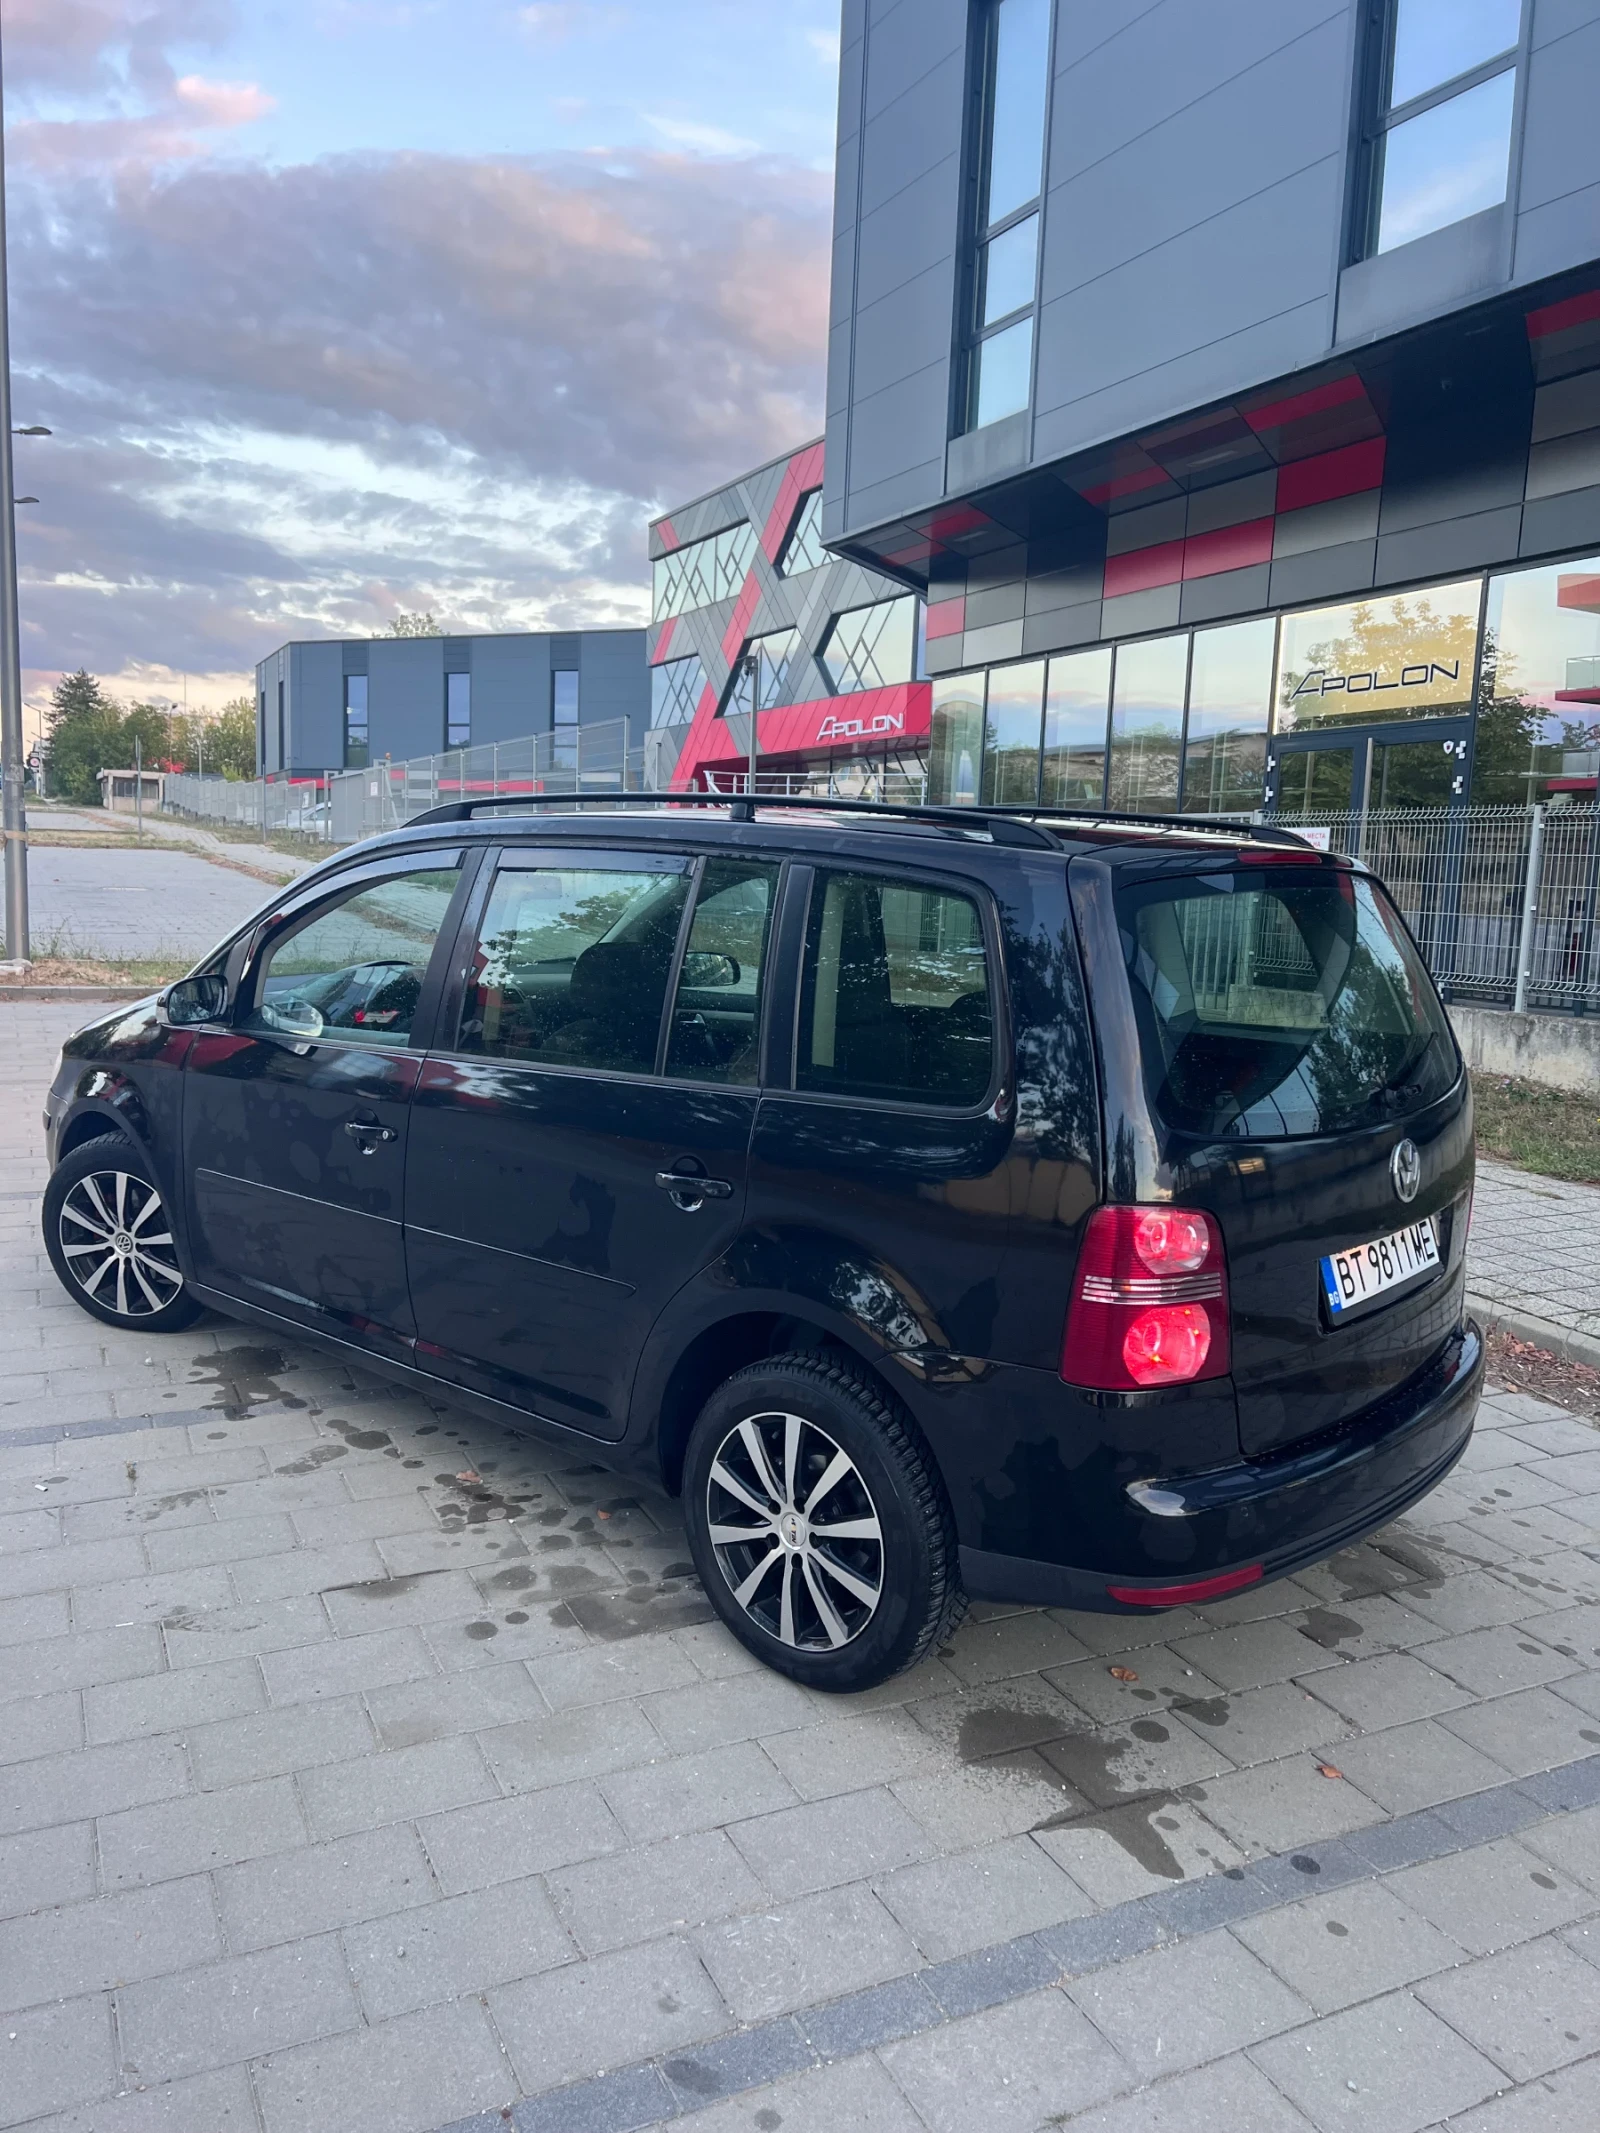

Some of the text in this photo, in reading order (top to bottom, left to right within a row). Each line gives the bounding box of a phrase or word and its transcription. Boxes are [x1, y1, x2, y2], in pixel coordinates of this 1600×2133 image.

[1290, 659, 1460, 701] APOLON
[816, 712, 904, 741] APOLON
[1327, 1290, 1341, 1307] BG
